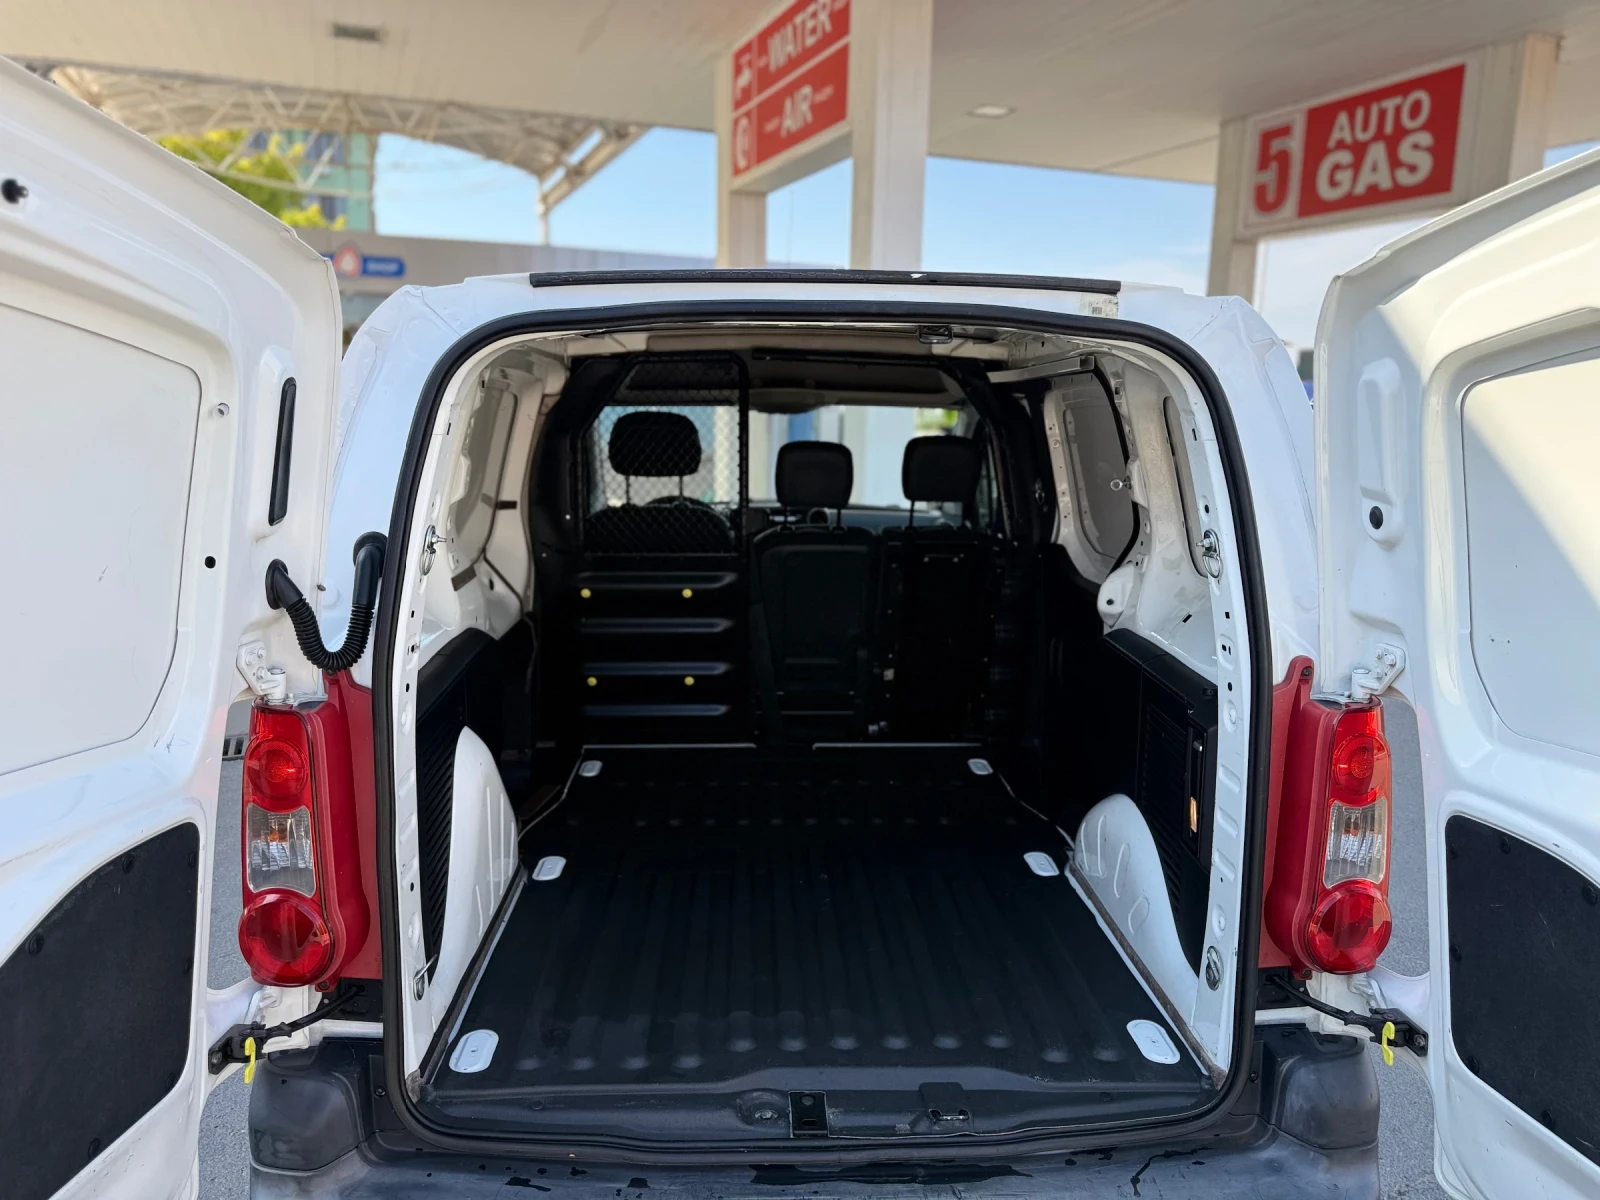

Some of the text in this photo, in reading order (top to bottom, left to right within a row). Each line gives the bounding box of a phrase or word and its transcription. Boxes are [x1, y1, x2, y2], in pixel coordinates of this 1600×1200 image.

[767, 0, 832, 72] WATER
[780, 84, 812, 138] AIR
[1328, 89, 1431, 149] AUTO
[1254, 123, 1294, 216] 5
[1315, 130, 1434, 202] GAS
